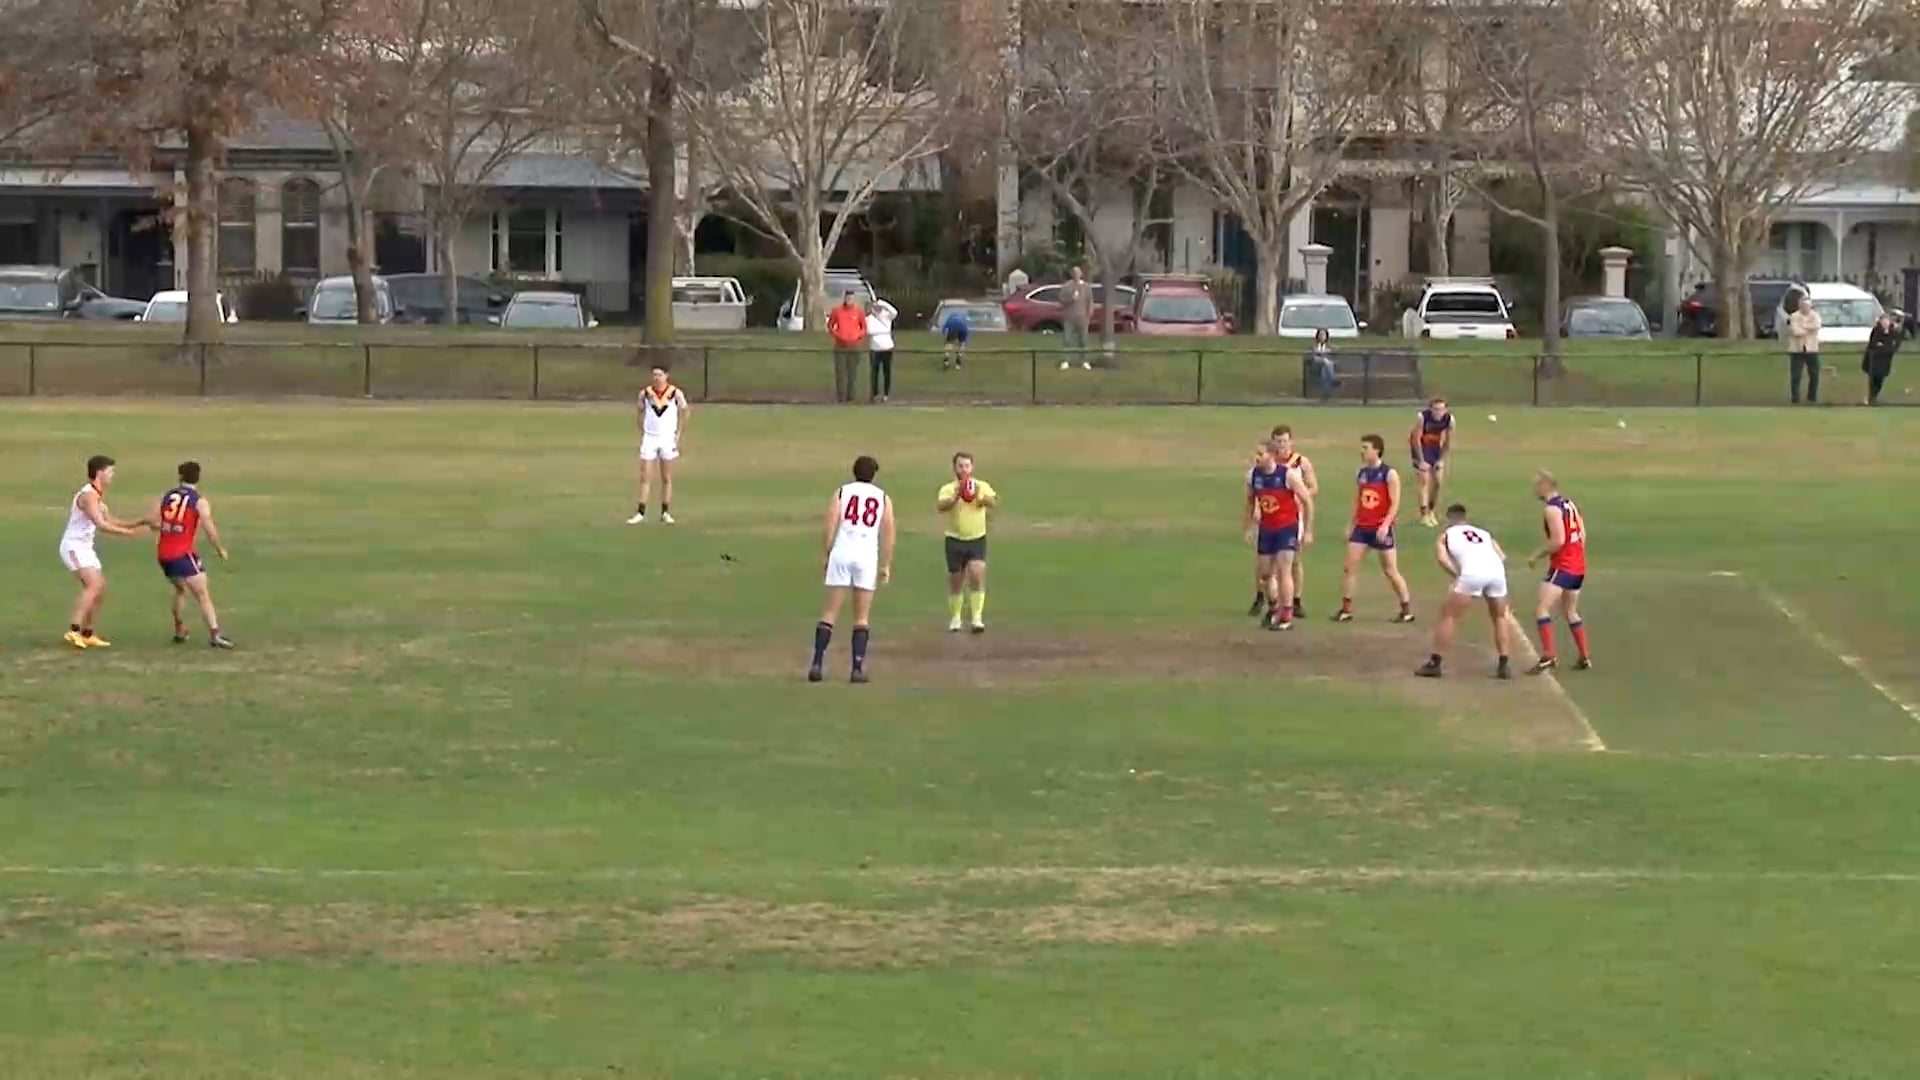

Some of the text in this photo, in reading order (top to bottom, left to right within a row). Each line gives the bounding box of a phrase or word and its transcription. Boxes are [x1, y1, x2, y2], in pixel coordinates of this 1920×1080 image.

[164, 493, 190, 521] 31
[844, 494, 879, 528] 48
[1462, 529, 1483, 544] 8
